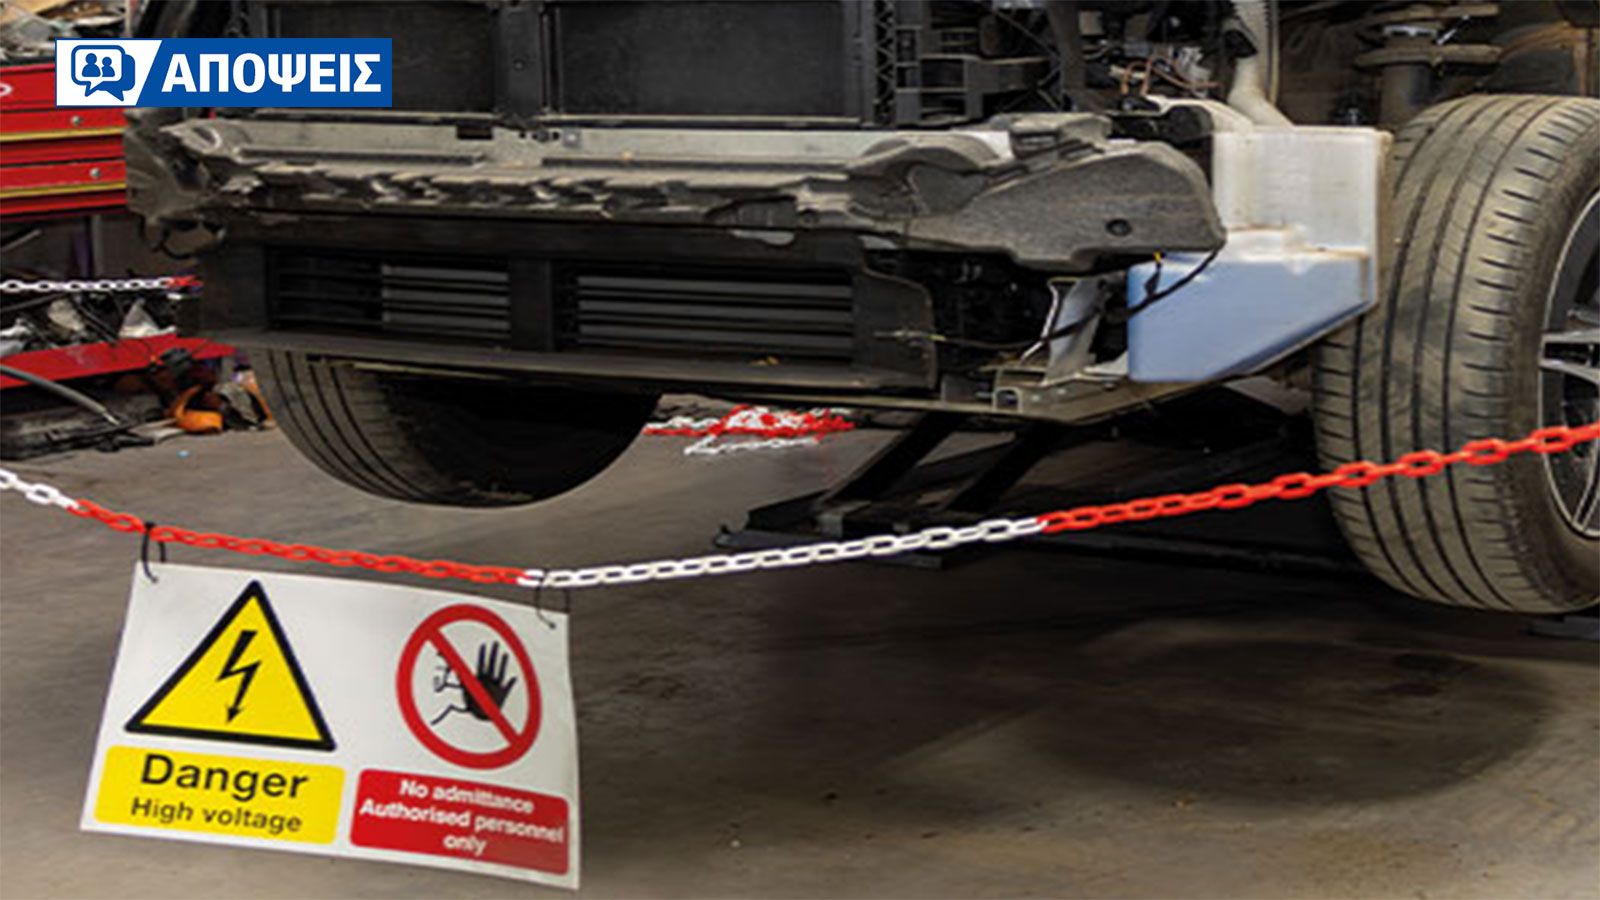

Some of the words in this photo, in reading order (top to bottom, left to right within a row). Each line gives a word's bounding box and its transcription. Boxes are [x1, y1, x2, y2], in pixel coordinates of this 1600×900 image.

[140, 753, 309, 802] Danger
[399, 779, 429, 799] No
[432, 784, 535, 814] admittance
[131, 796, 194, 824] High
[202, 807, 302, 834] voltage
[359, 798, 470, 828] Authorised
[474, 814, 564, 843] personnel
[443, 834, 486, 856] only
